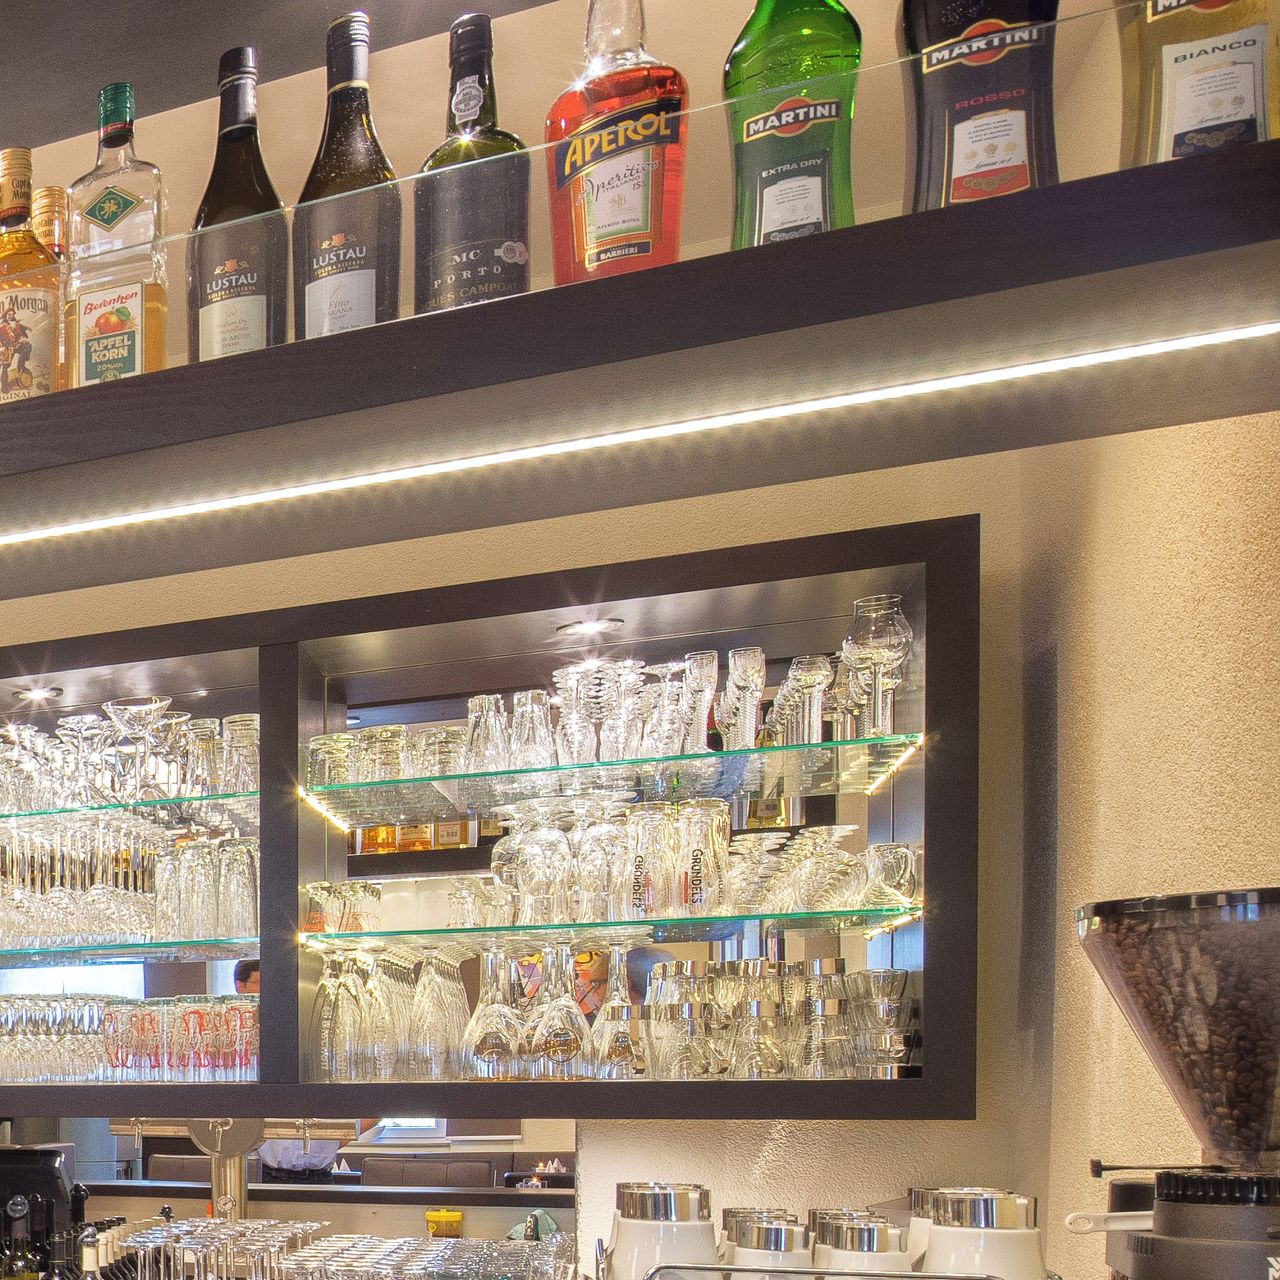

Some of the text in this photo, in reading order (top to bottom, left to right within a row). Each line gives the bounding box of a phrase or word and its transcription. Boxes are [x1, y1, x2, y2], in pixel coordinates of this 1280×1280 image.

[931, 28, 1038, 65] MARTINI
[1174, 39, 1257, 64] BIANCO
[954, 88, 1025, 110] ROSSO
[749, 104, 836, 136] MARTINI
[564, 111, 671, 176] APEROL
[762, 158, 823, 178] EXTRA DRY
[576, 161, 659, 206] Aperitivo
[603, 175, 641, 193] ITALIANO
[313, 246, 367, 269] LUSTAU
[452, 249, 480, 265] MC
[600, 246, 638, 260] BARBIERI
[206, 273, 257, 294] LUSTAU
[434, 265, 501, 290] PORTO
[7, 294, 49, 316] Morgan
[84, 291, 138, 315] Berentzen
[89, 335, 131, 352] APFEL
[92, 346, 128, 364] KORN
